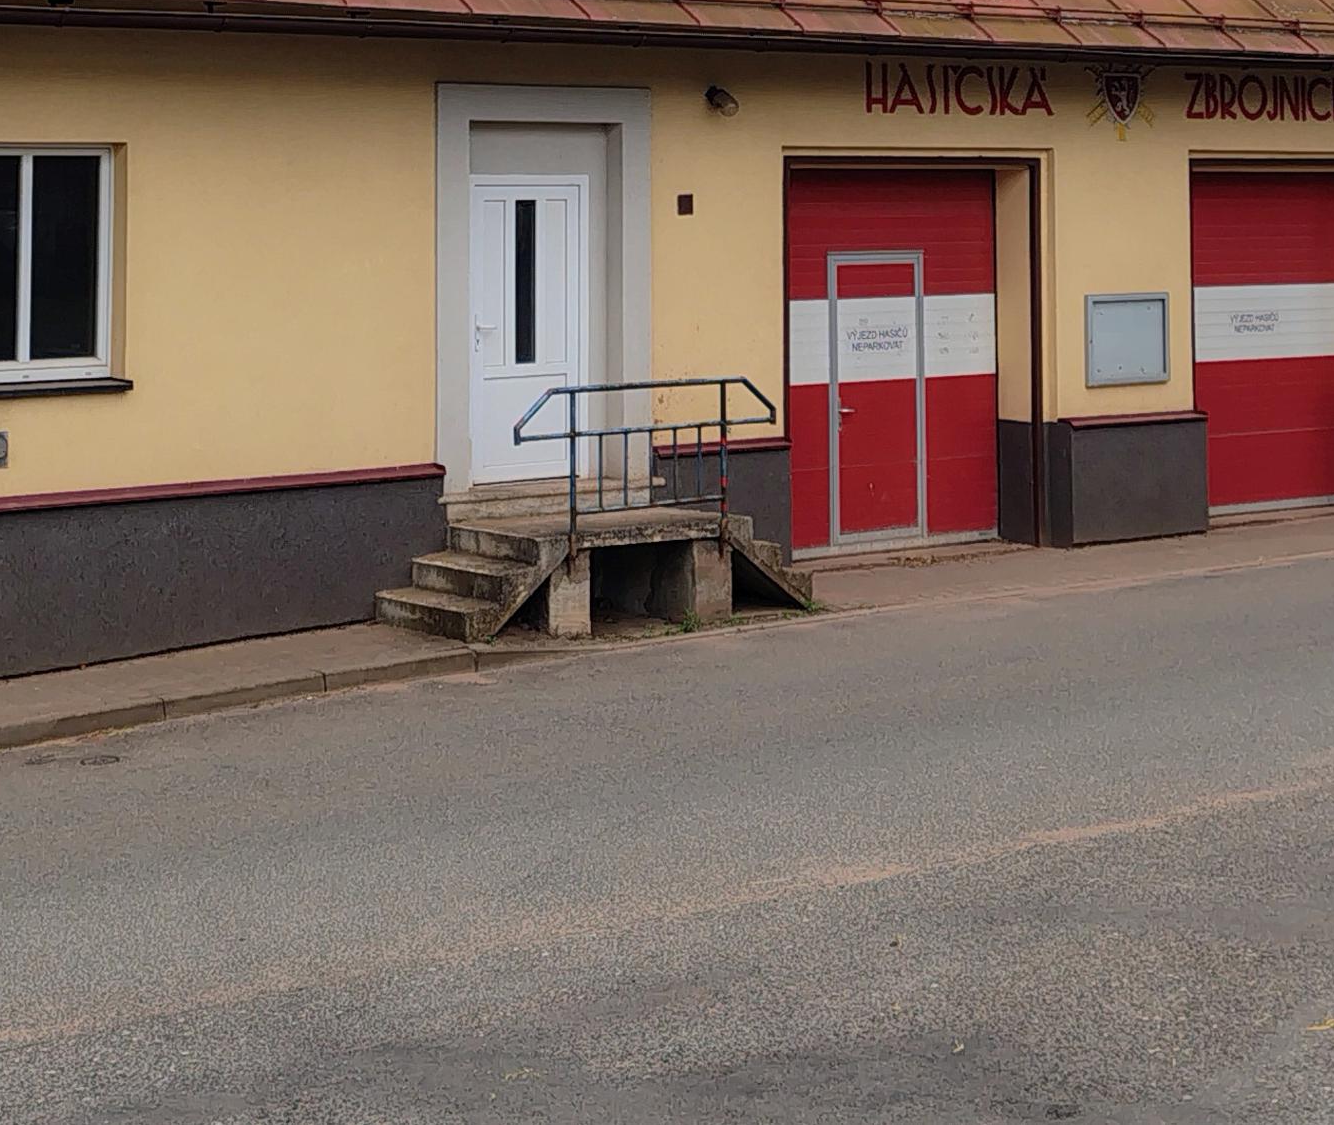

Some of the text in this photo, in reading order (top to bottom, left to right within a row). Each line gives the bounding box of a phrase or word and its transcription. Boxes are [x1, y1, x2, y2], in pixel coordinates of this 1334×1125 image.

[865, 61, 1055, 116] HASIČSKÁ
[846, 329, 877, 341] VÝJEZD
[851, 340, 904, 352] NEPARKOVAT
